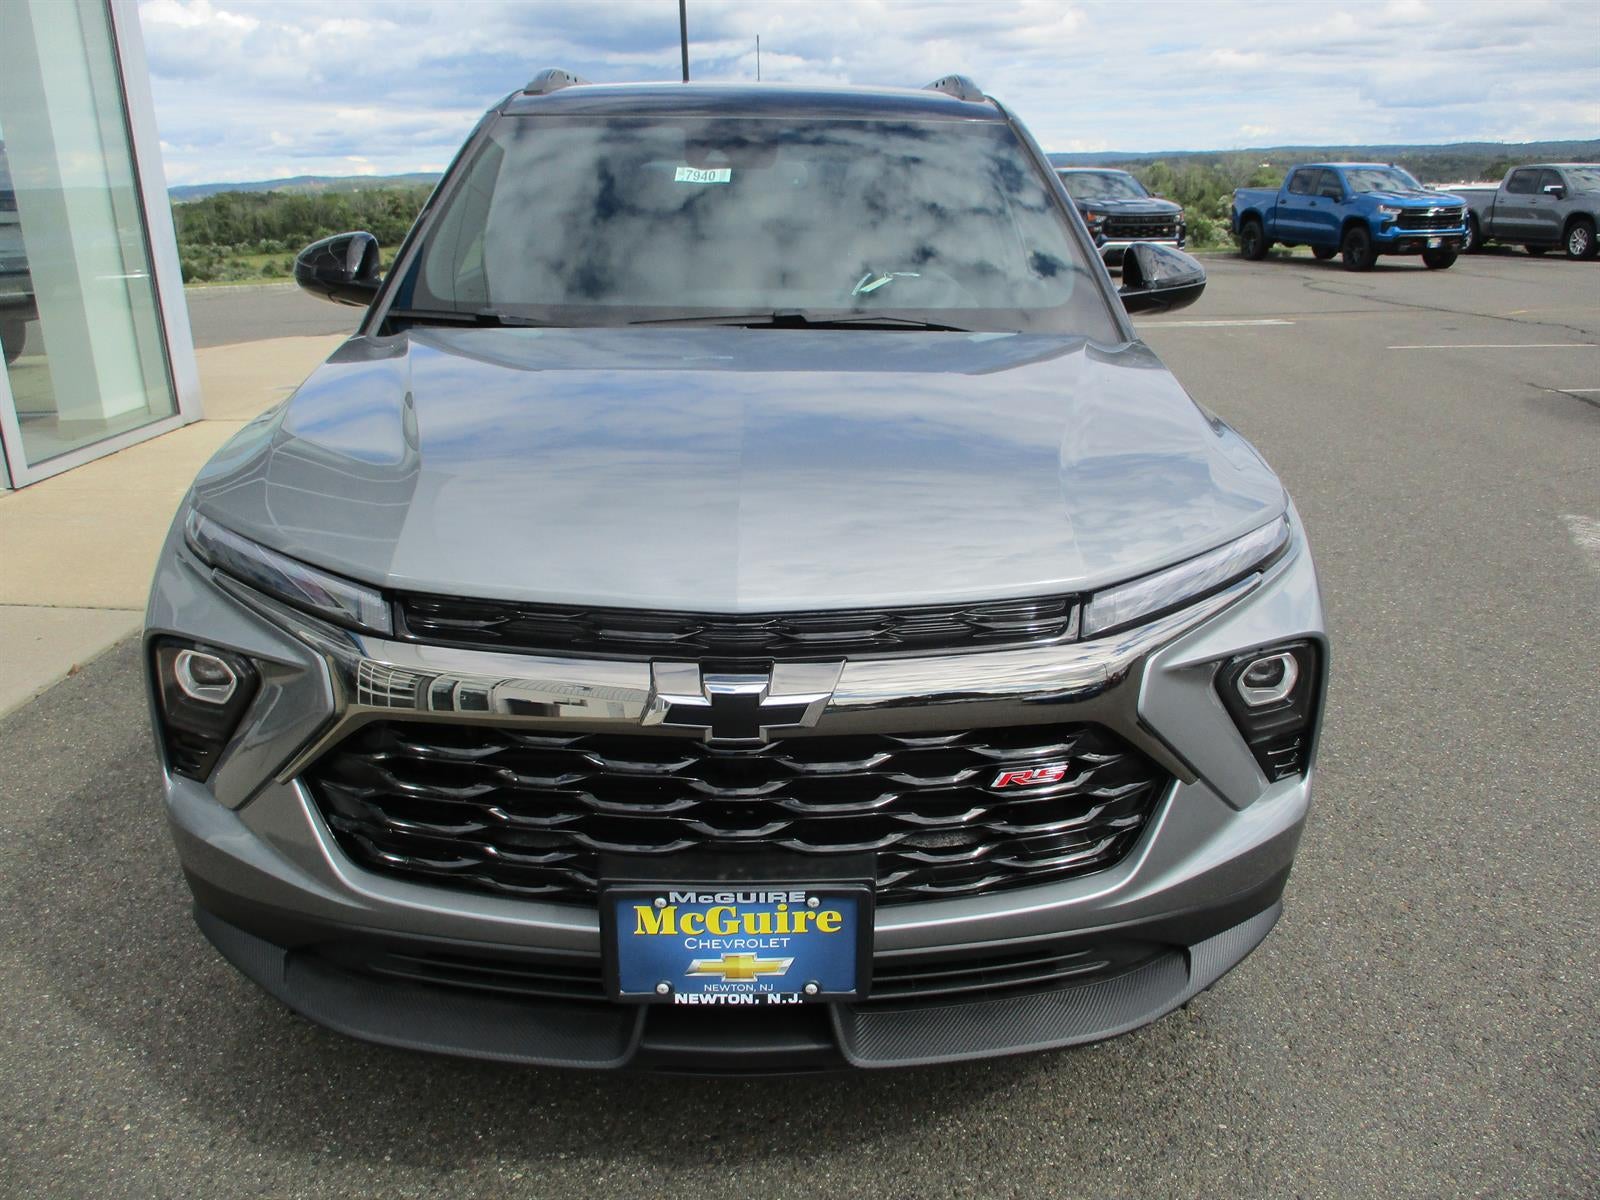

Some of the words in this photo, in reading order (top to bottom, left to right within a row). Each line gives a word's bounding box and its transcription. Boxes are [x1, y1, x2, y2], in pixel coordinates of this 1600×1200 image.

[686, 169, 716, 181] 7940
[991, 764, 1068, 787] RS
[669, 891, 806, 903] McGUIRE
[633, 904, 842, 935] McGuire
[684, 937, 790, 949] CHEVROLET
[704, 983, 757, 992] NEWTON,
[760, 983, 774, 992] NJ
[674, 993, 759, 1005] NEWTON,
[767, 993, 803, 1004] N.J.
